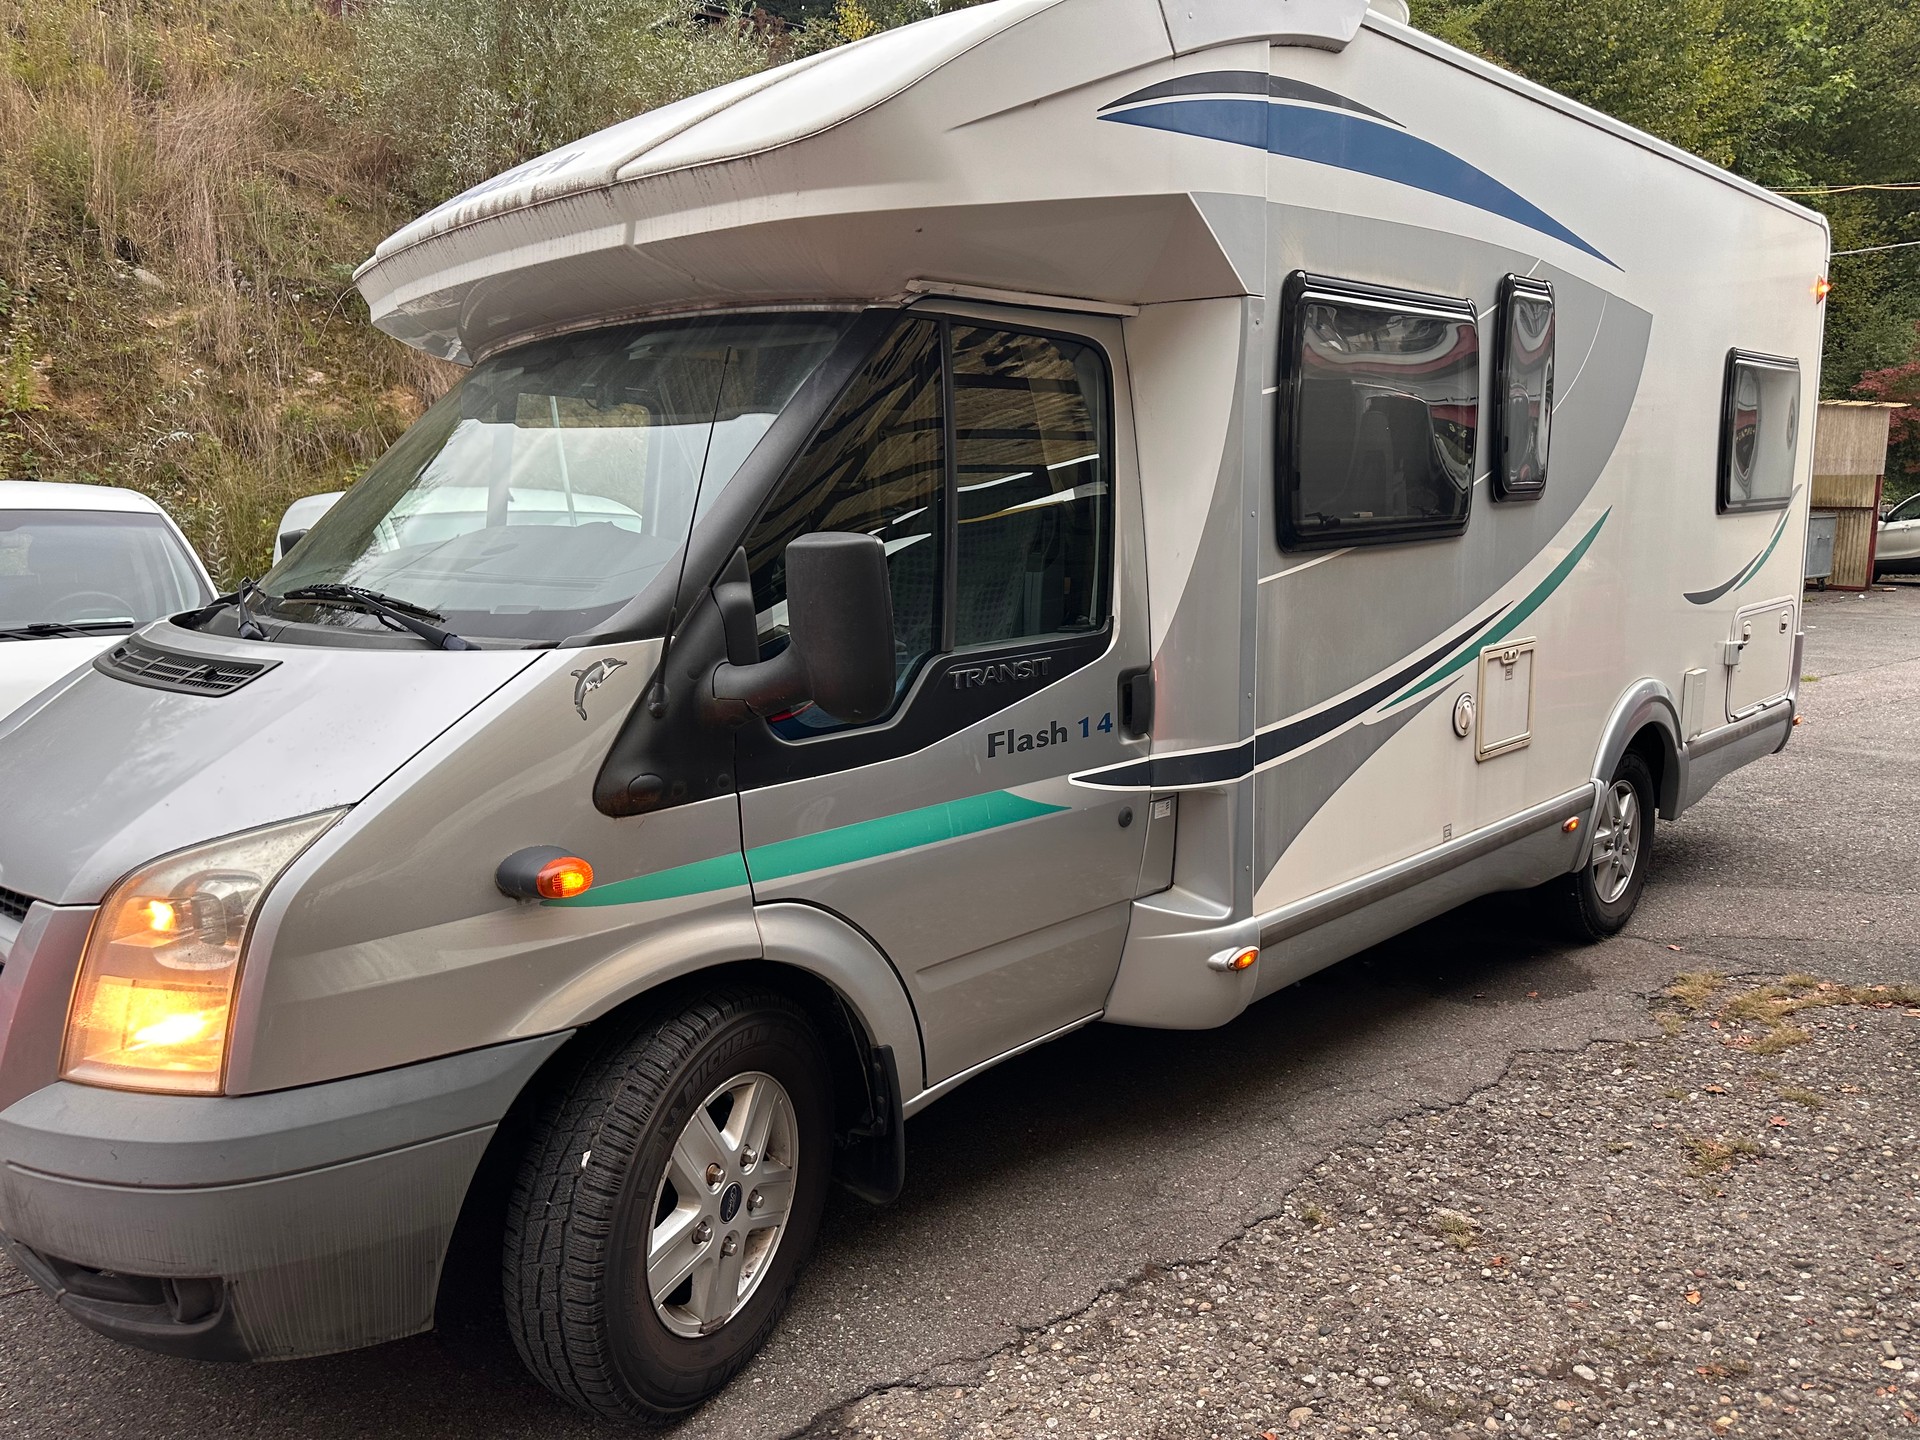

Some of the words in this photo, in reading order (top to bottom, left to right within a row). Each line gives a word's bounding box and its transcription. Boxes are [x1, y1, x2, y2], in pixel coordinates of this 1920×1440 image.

[948, 656, 1052, 690] TRANSIT
[987, 720, 1068, 758] Flash
[1077, 712, 1113, 738] 14
